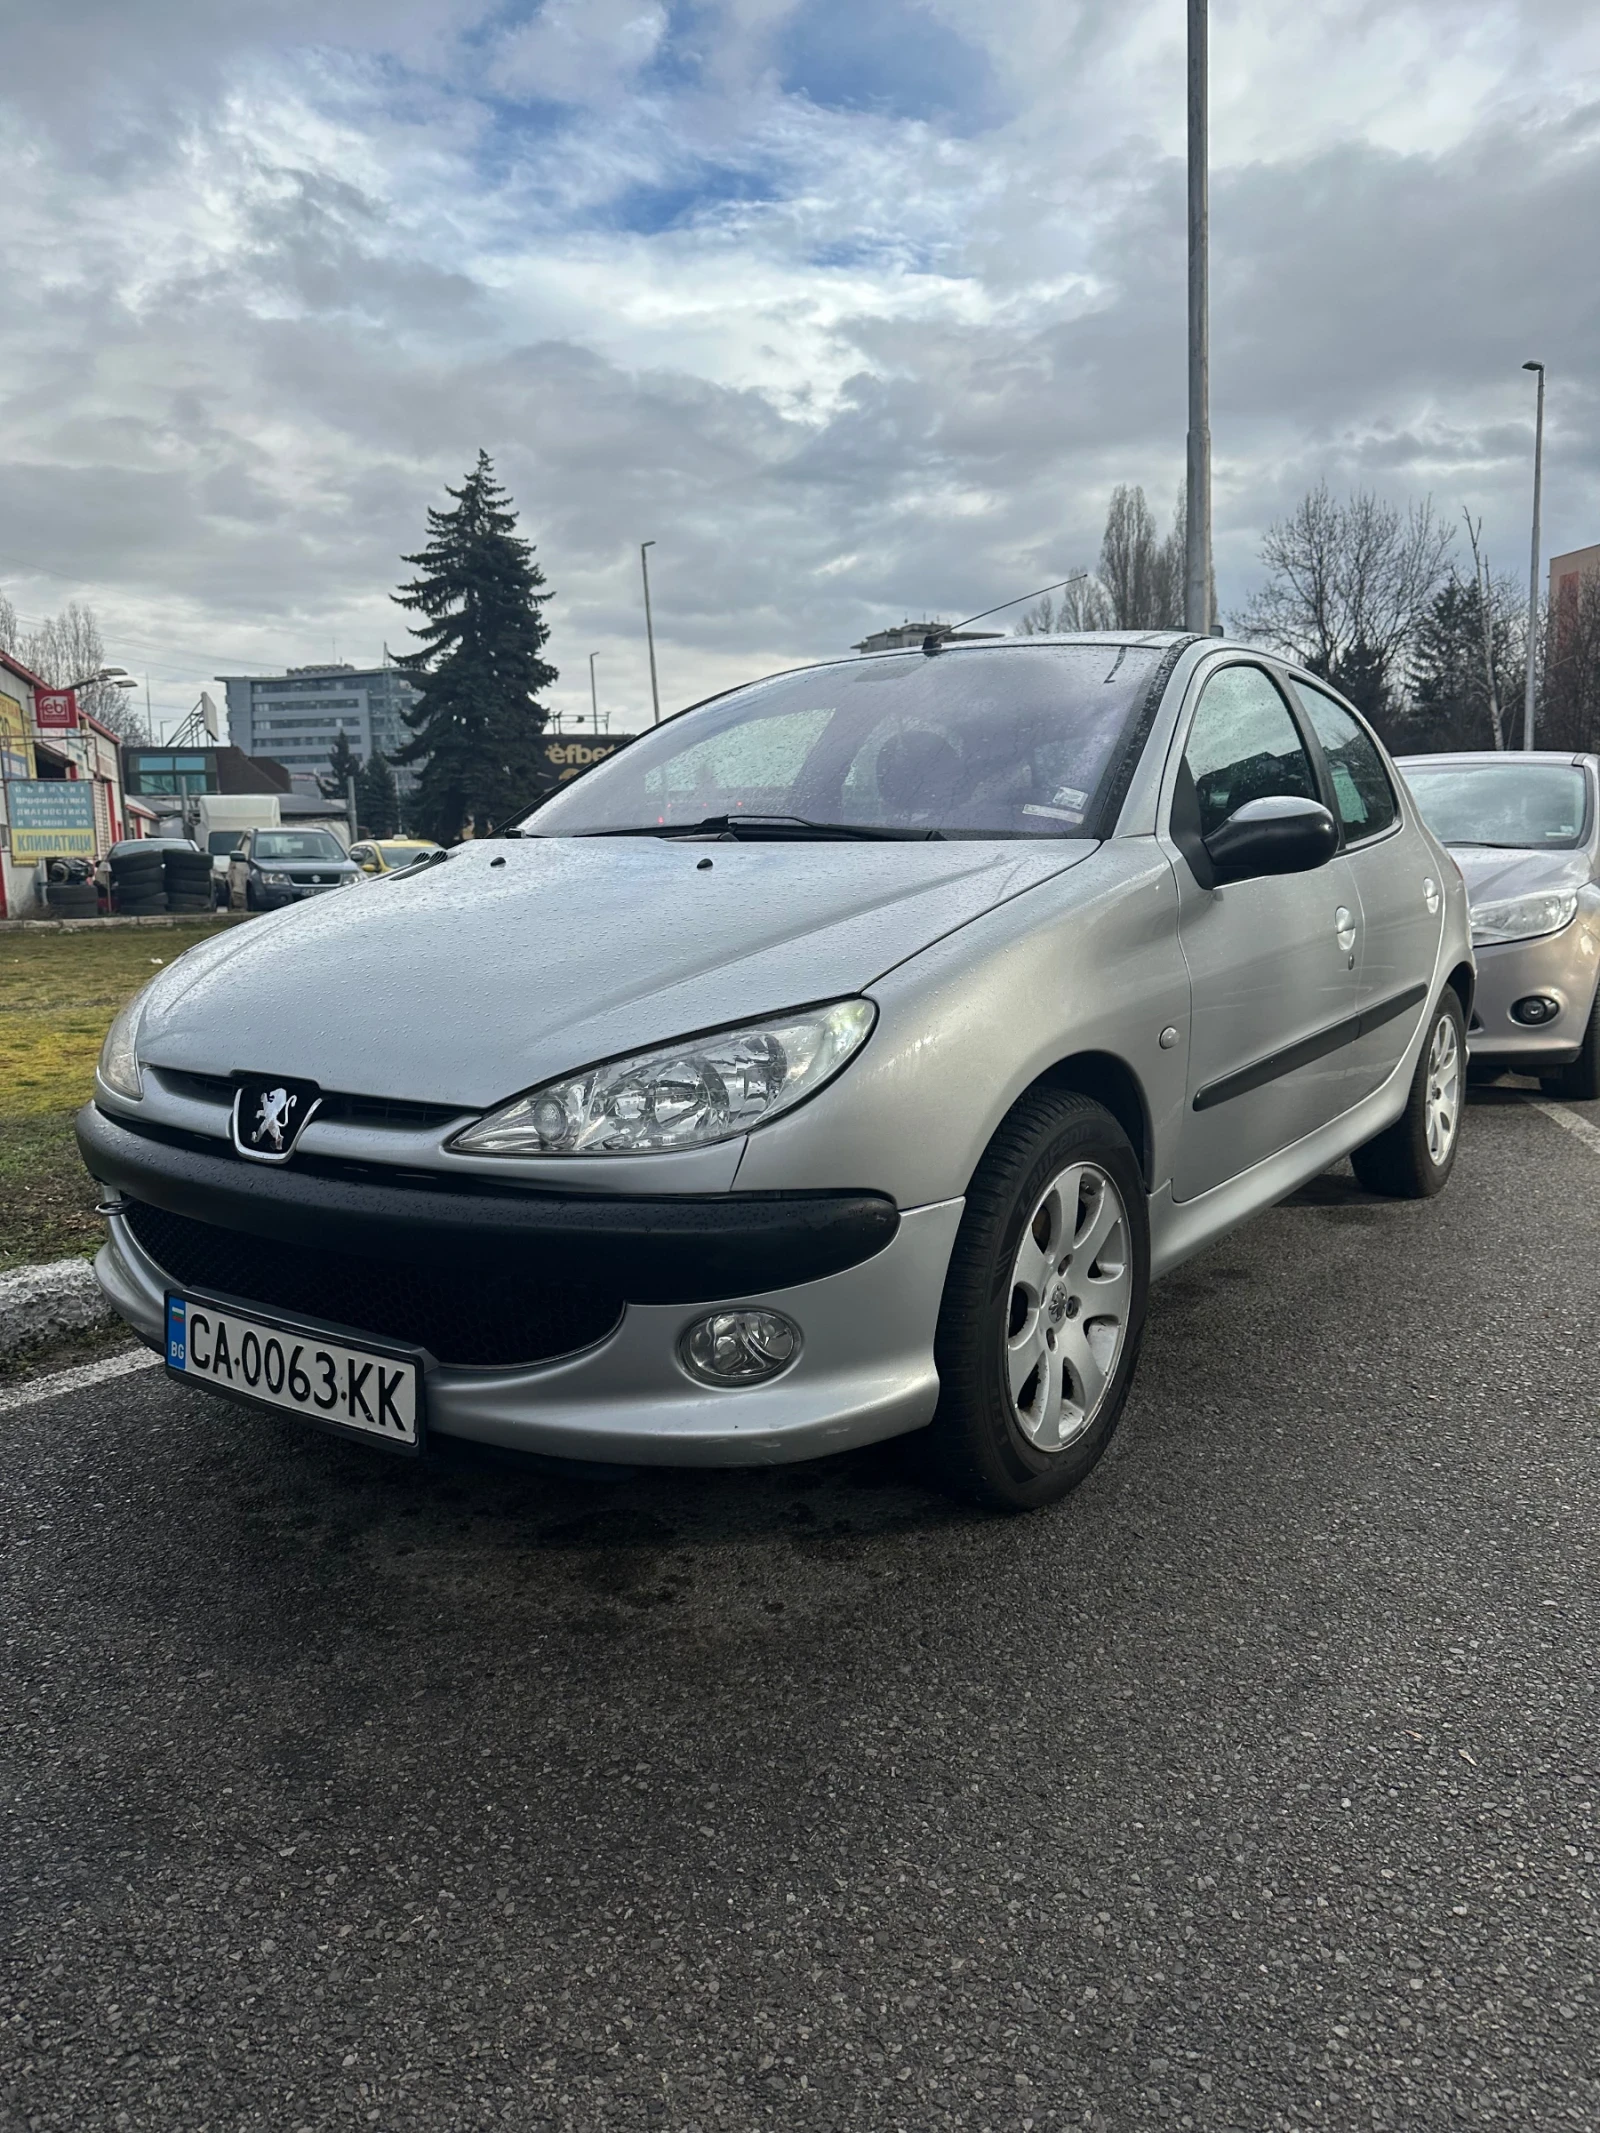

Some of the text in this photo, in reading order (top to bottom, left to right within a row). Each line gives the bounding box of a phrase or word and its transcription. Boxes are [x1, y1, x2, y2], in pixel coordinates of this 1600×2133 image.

[41, 697, 67, 714] febi
[16, 808, 88, 816] ДИАГНОСТИКА
[31, 819, 68, 827] РЕМОНТ
[17, 834, 92, 853] КЛИМАТИЦИ
[170, 1340, 185, 1360] BG
